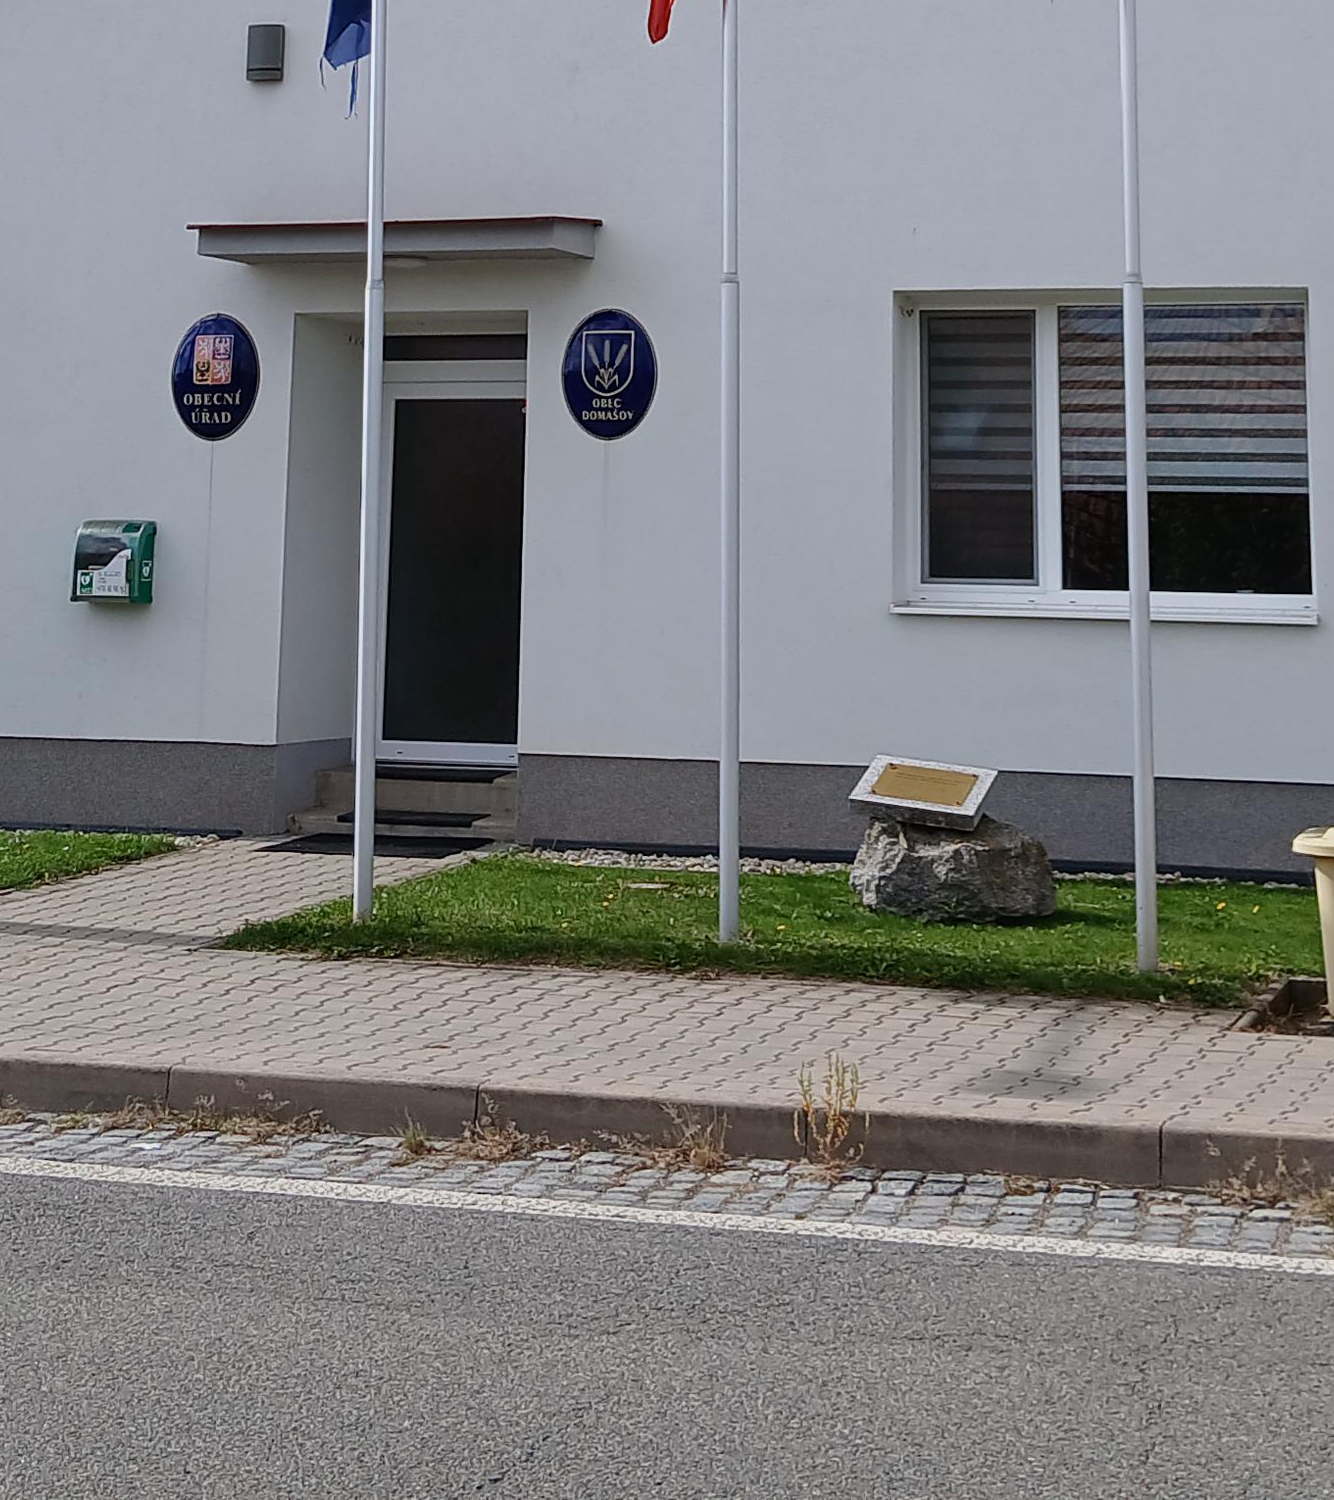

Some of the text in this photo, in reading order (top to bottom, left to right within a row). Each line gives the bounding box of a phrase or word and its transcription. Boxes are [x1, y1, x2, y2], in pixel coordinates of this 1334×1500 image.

[183, 389, 241, 405] OBECNÍ
[592, 398, 623, 408] OBEC
[191, 408, 232, 423] ÚŘAD
[582, 408, 635, 420] DOMAŠOV
